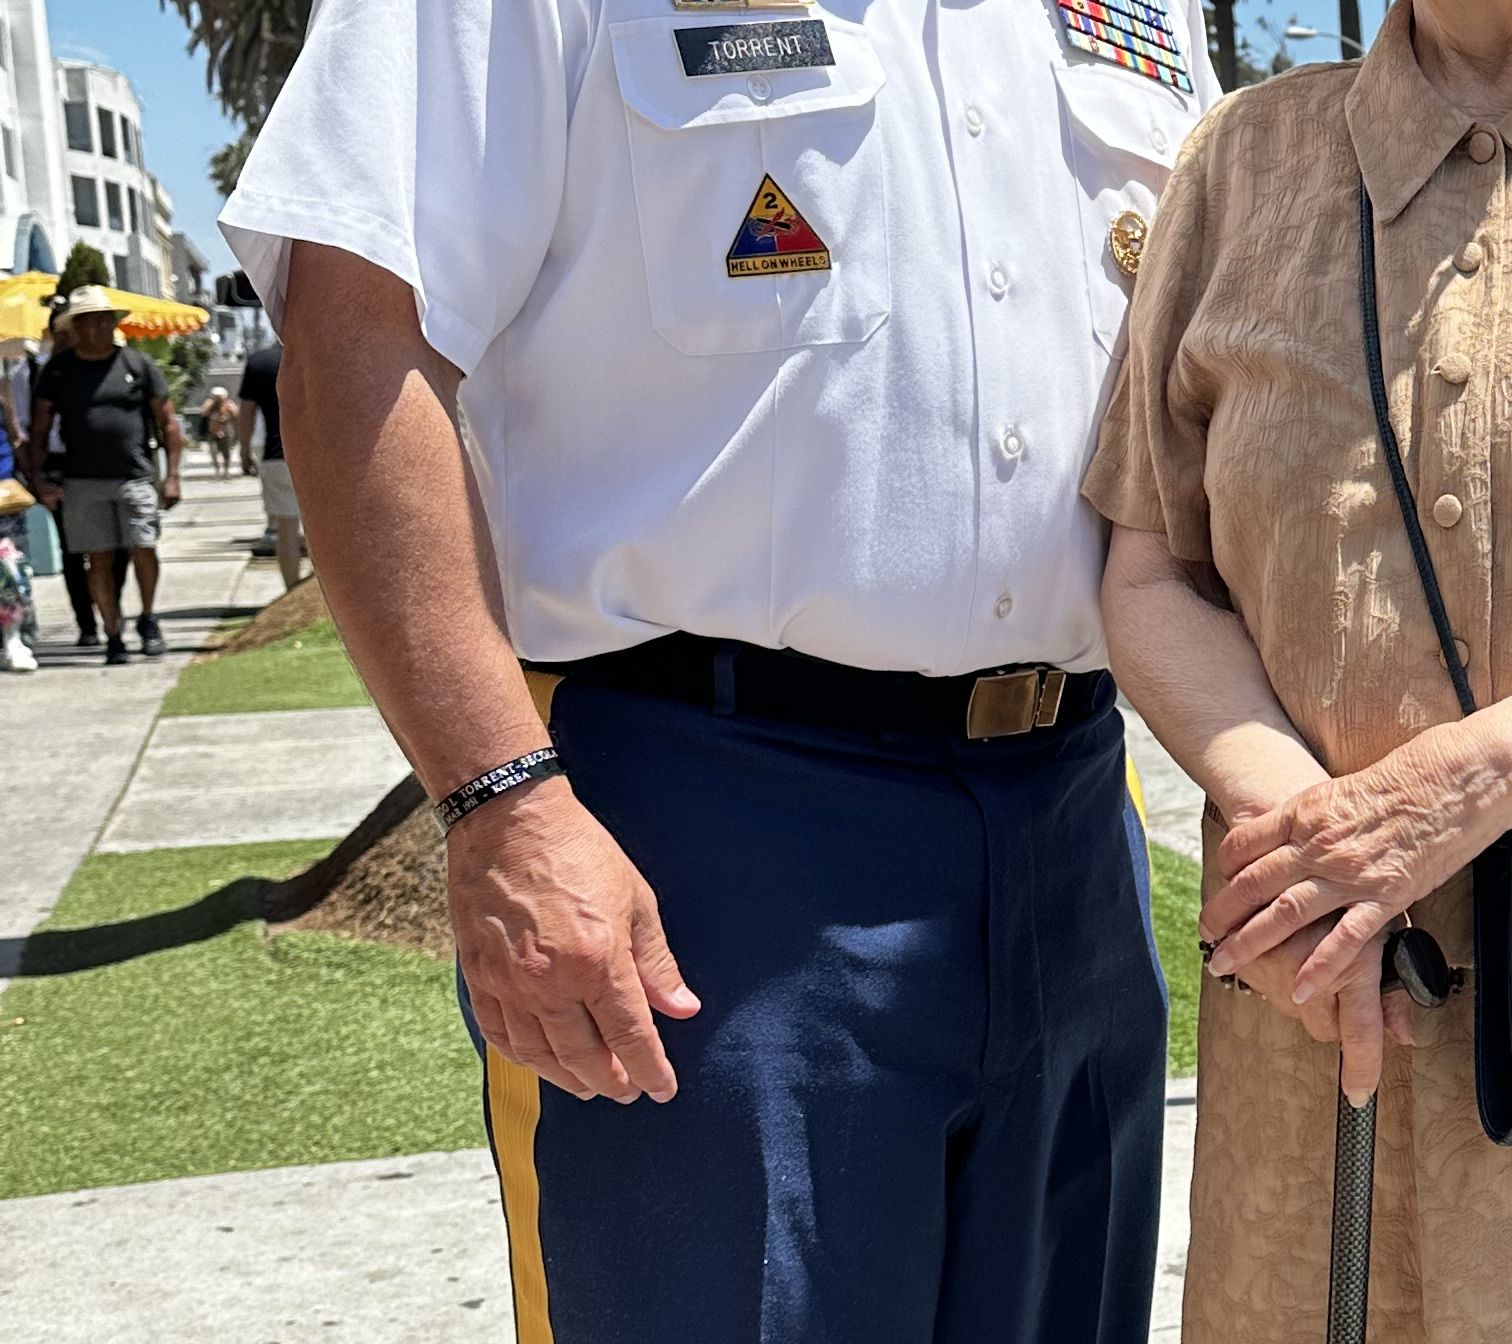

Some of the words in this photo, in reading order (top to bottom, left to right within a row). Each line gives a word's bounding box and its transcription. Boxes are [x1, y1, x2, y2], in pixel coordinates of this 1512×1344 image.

[707, 34, 802, 61] TORRENT
[762, 192, 778, 209] 2
[730, 258, 760, 272] HELL
[761, 258, 778, 270] ON
[779, 255, 827, 269] WHEELS
[491, 771, 532, 794] KOREA
